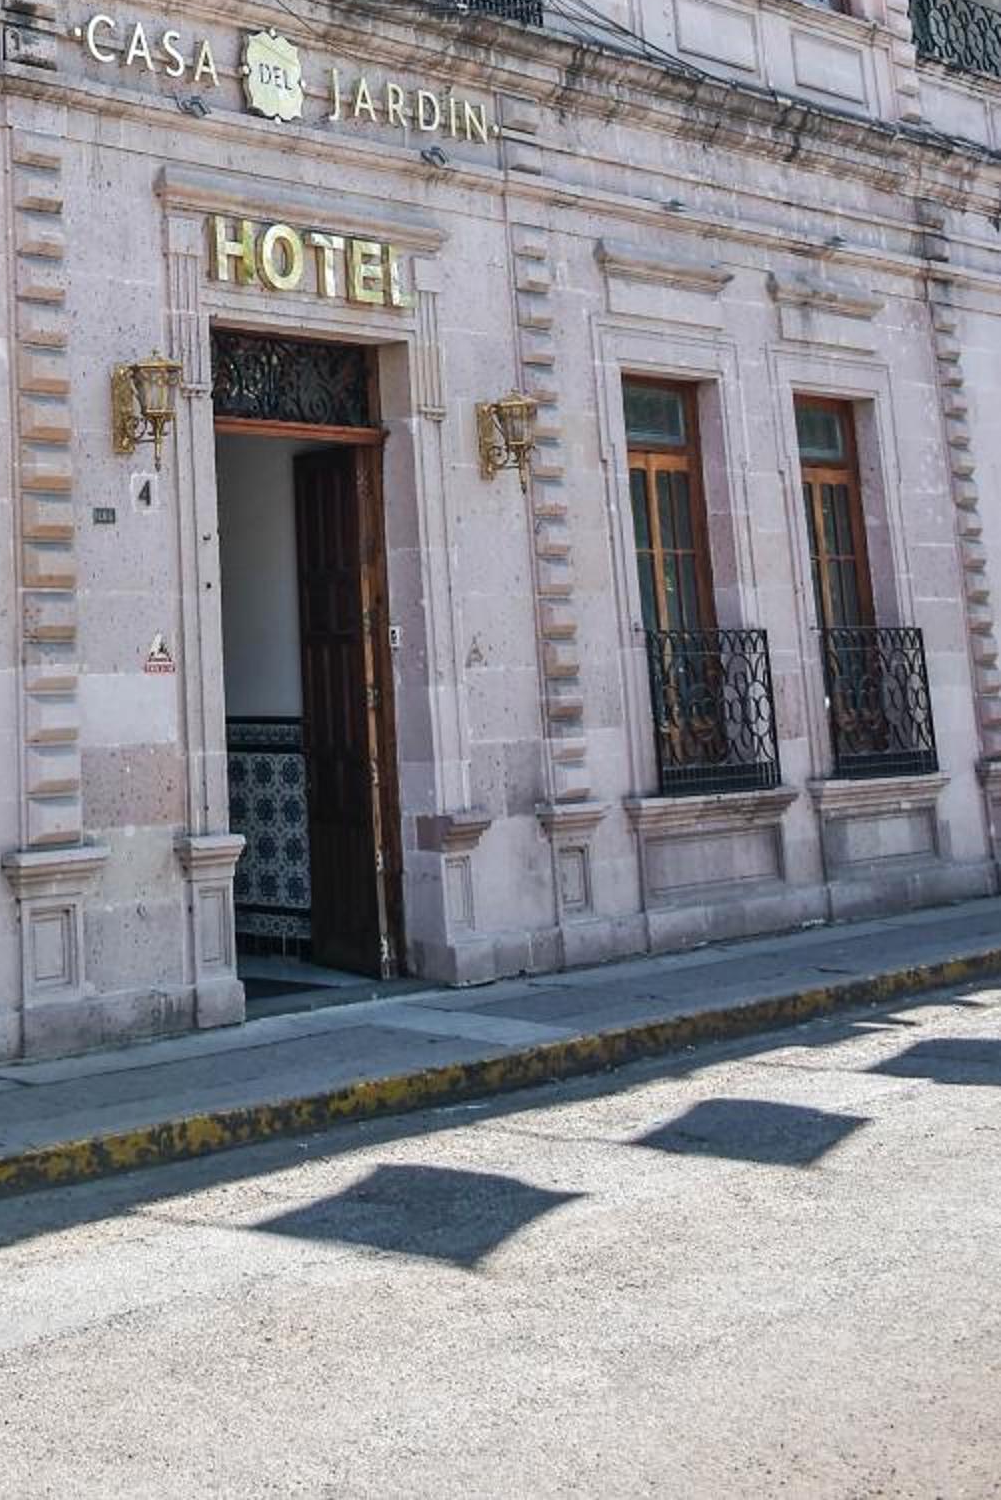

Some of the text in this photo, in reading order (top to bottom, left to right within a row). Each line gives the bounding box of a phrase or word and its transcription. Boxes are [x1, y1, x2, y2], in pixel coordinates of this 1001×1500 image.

[87, 14, 220, 87] CASA
[259, 62, 293, 91] DEL
[207, 213, 420, 308] HOTEL
[138, 479, 151, 507] 4
